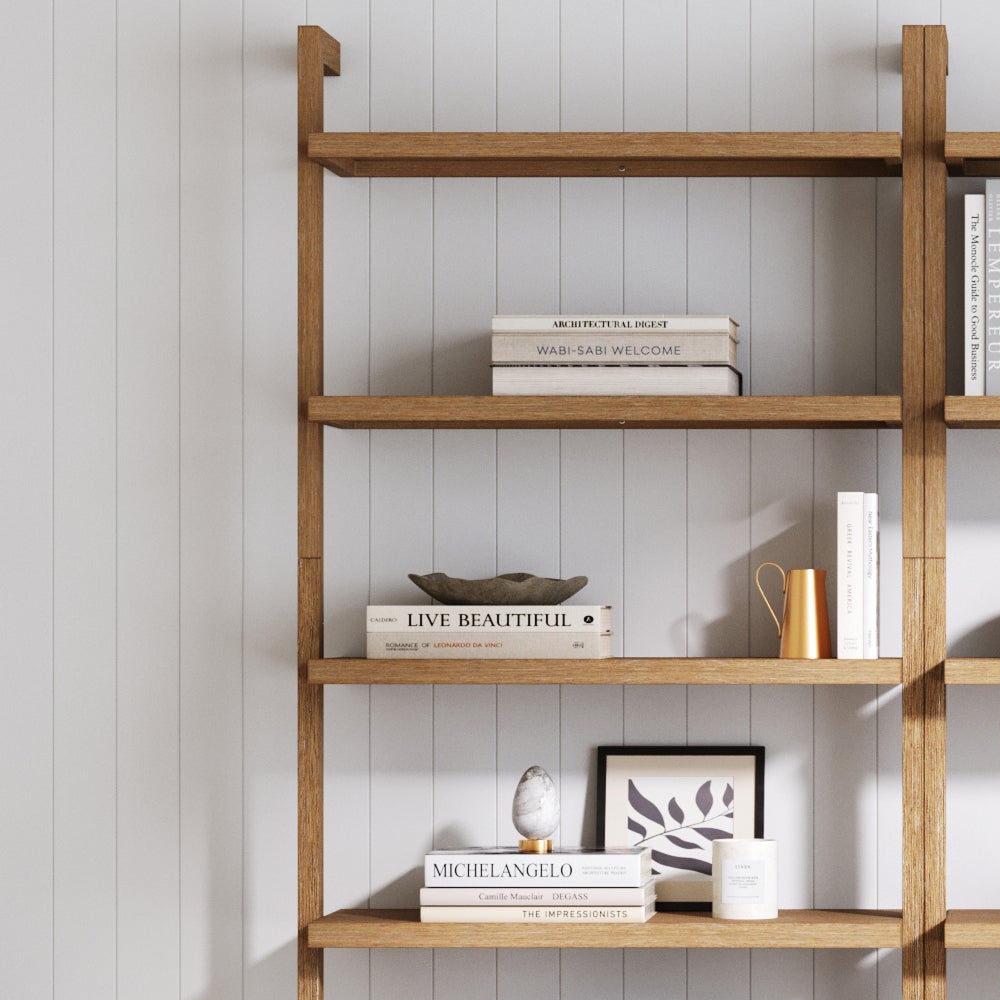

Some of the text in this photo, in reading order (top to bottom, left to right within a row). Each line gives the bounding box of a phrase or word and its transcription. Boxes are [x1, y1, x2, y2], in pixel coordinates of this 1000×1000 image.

[971, 213, 979, 381] The Monocle Guide to Good Business
[988, 228, 1000, 371] LEMPEREUR
[553, 320, 669, 328] ARCHITECTURAL DIGEST
[536, 345, 681, 356] WABI-SABI WELCOME
[407, 613, 572, 627] LIVE BEAUTIFUL
[432, 863, 573, 879] MICHELANGELO
[478, 892, 589, 901] Camille Mauclair DEGASS
[522, 910, 628, 918] THE IMPRESSIONISTS
